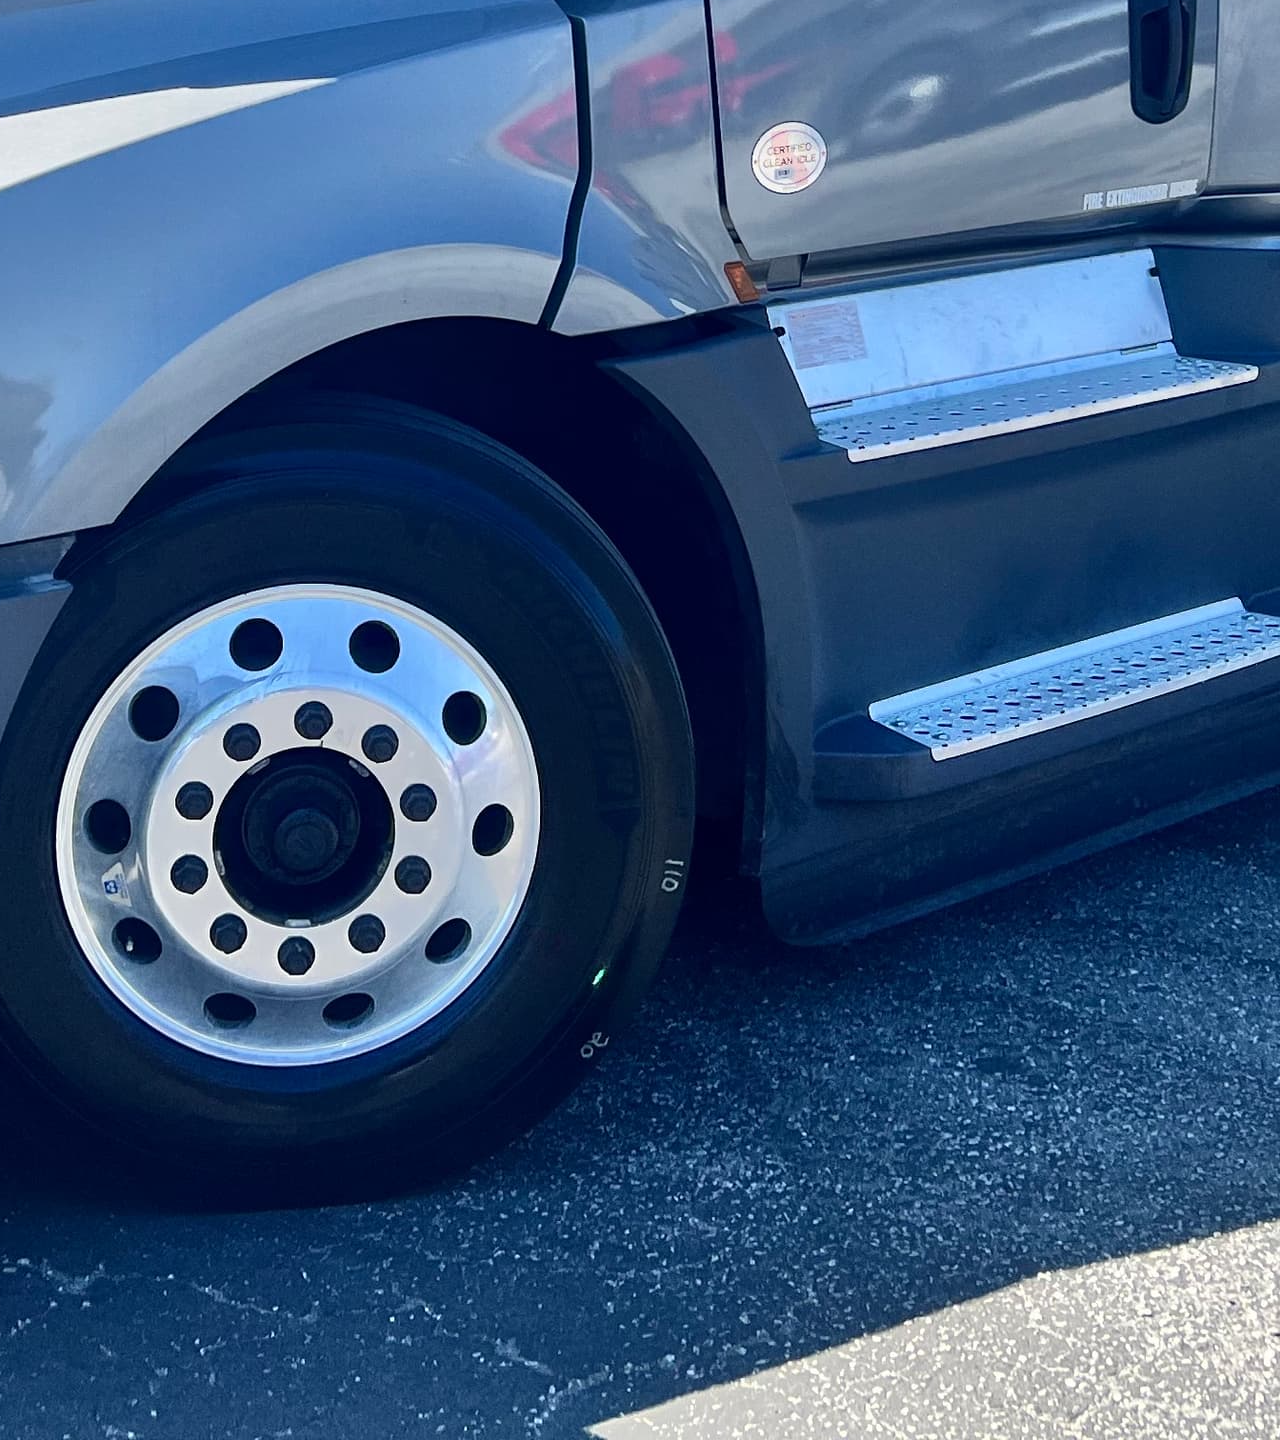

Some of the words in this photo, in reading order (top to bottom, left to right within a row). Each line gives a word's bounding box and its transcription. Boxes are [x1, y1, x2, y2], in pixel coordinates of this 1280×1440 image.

[766, 142, 813, 156] CERTIFIED
[762, 157, 794, 169] CLEAN
[796, 153, 817, 164] IDLE
[1083, 191, 1104, 211] FIRE
